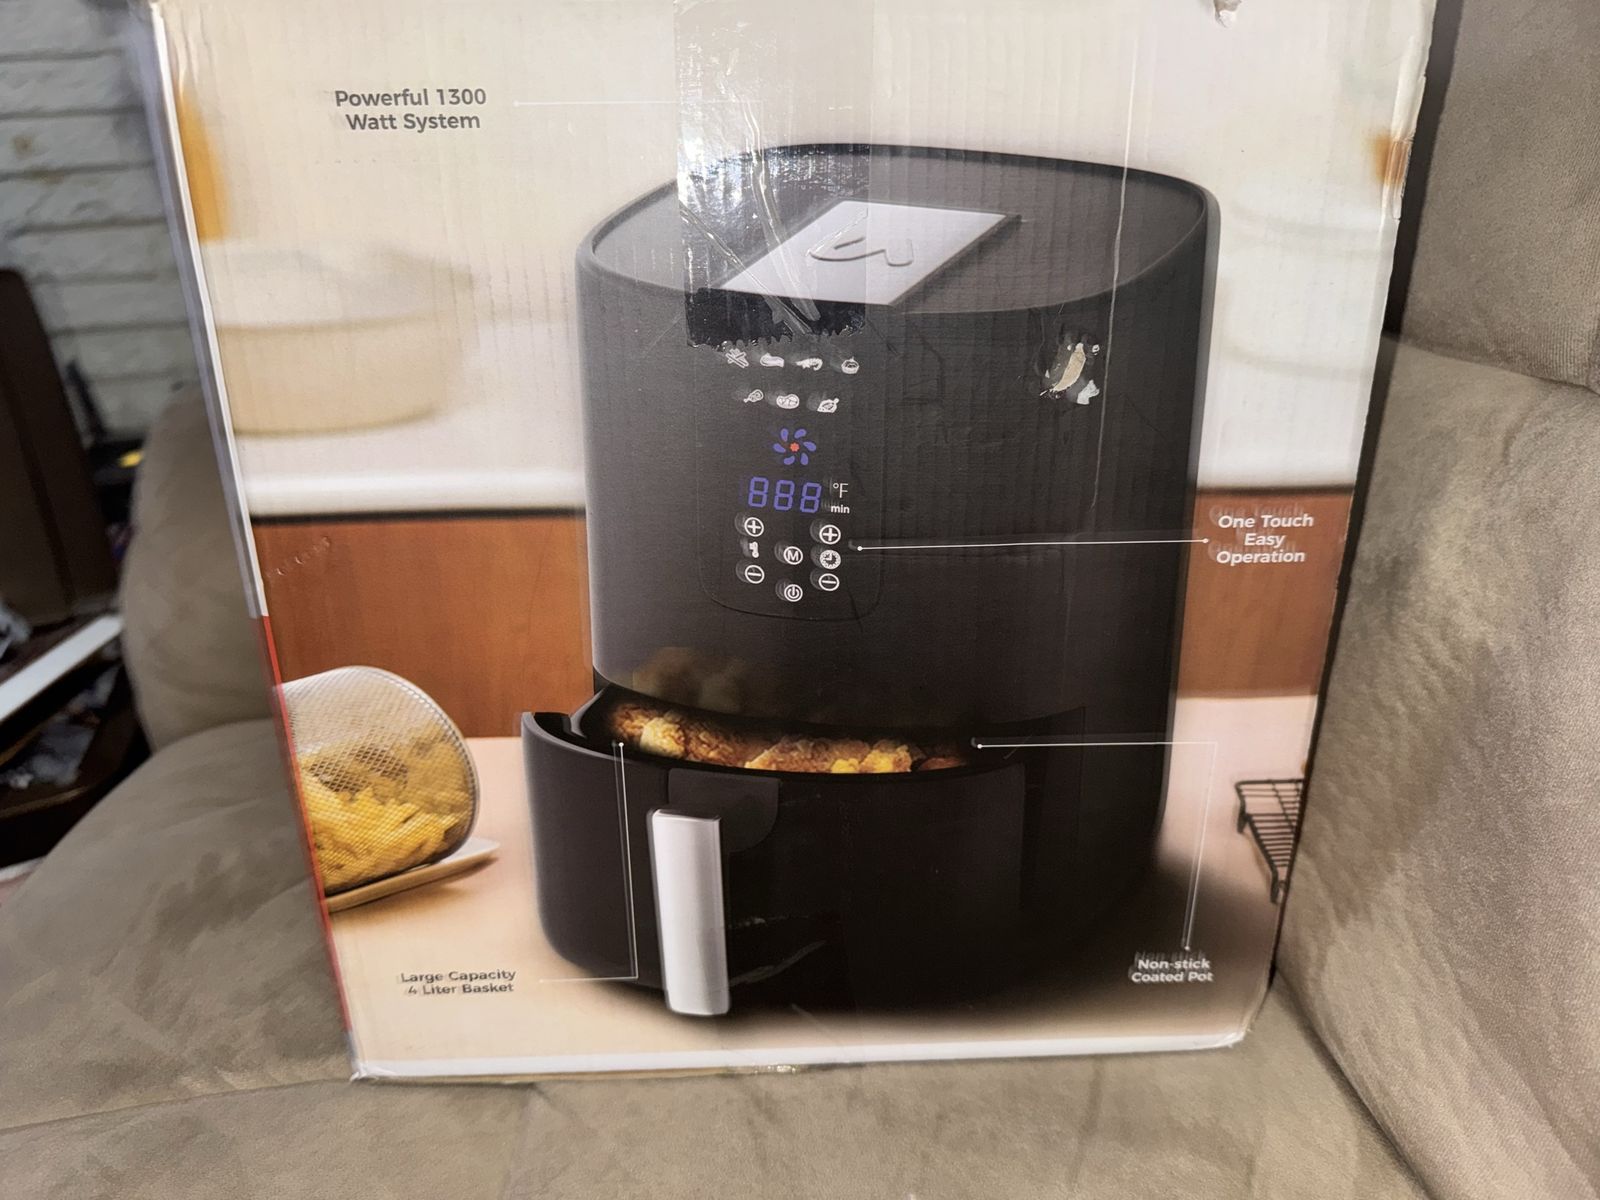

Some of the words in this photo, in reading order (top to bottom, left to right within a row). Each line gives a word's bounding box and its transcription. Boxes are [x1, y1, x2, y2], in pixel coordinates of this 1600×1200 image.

[335, 88, 429, 107] Powerful
[436, 88, 487, 105] 1300
[345, 113, 397, 130] Watt
[403, 113, 481, 133] System
[831, 504, 850, 514] min
[1218, 515, 1256, 528] One
[1261, 513, 1314, 528] Touch
[1244, 533, 1286, 548] Easy
[1216, 549, 1305, 566] Operation
[1137, 958, 1211, 969] Non-stick
[400, 972, 443, 984] Large
[448, 969, 516, 982] Capacity
[1131, 971, 1184, 982] Coated
[1187, 971, 1214, 982] Pot
[407, 985, 417, 994] 4
[422, 984, 457, 995] Liter
[462, 983, 514, 993] Basket
